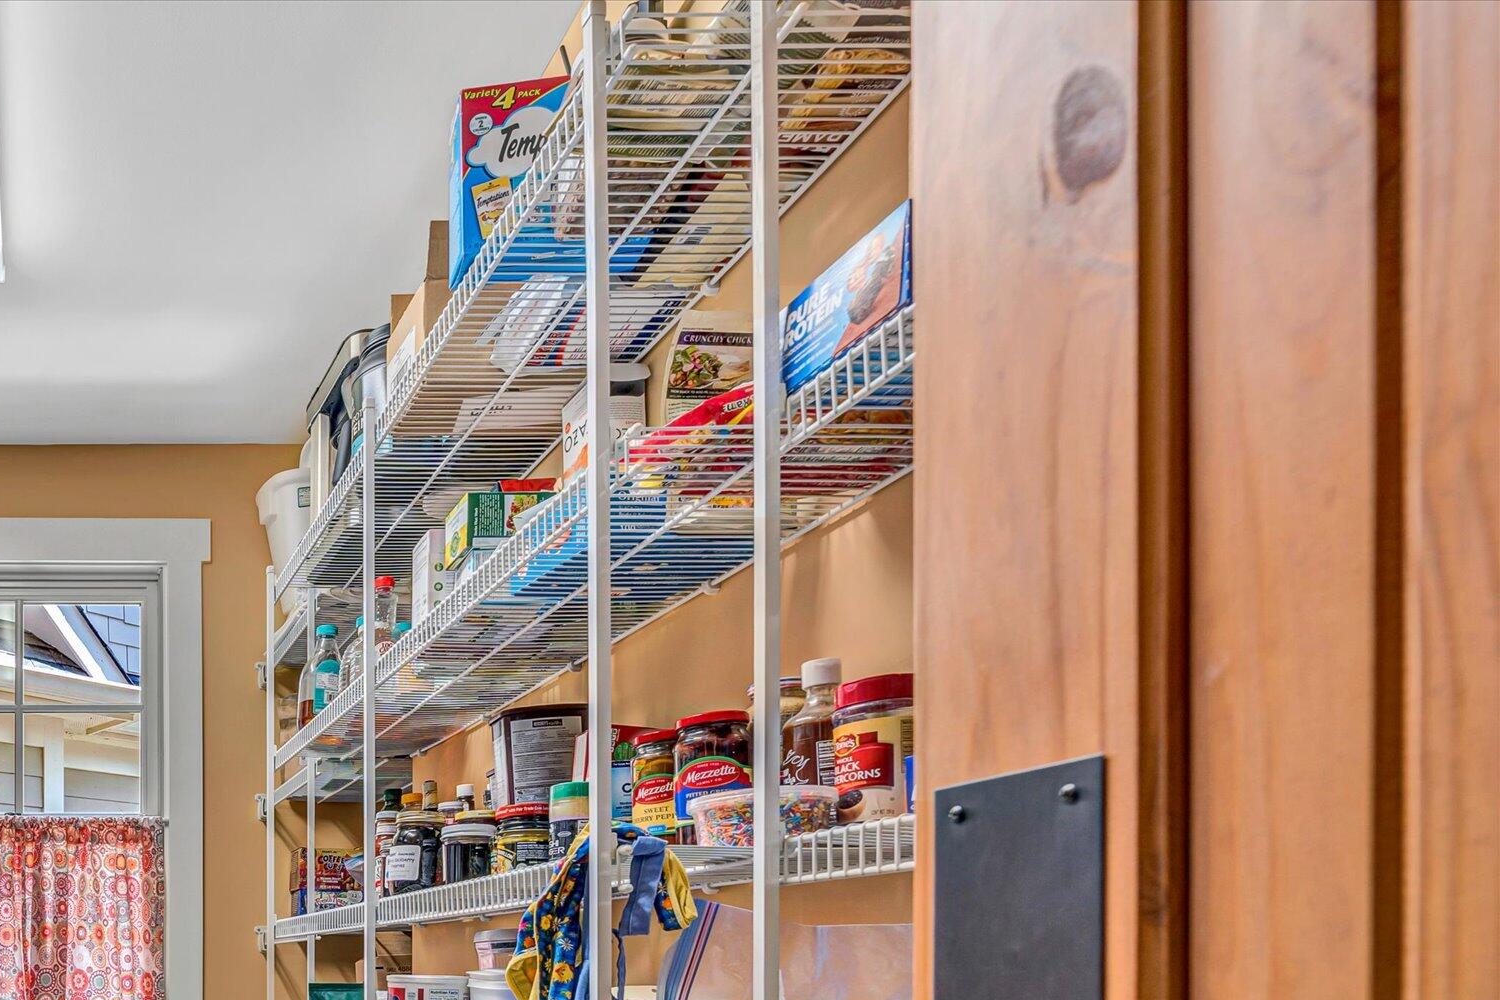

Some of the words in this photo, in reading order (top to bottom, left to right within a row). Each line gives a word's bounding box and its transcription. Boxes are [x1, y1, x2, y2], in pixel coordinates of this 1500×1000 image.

[464, 88, 501, 100] Variety
[492, 86, 516, 110] 4
[518, 88, 541, 98] PACK
[787, 281, 831, 328] PURE
[683, 333, 724, 344] CRUNCHY
[683, 765, 737, 785] Mezzetta
